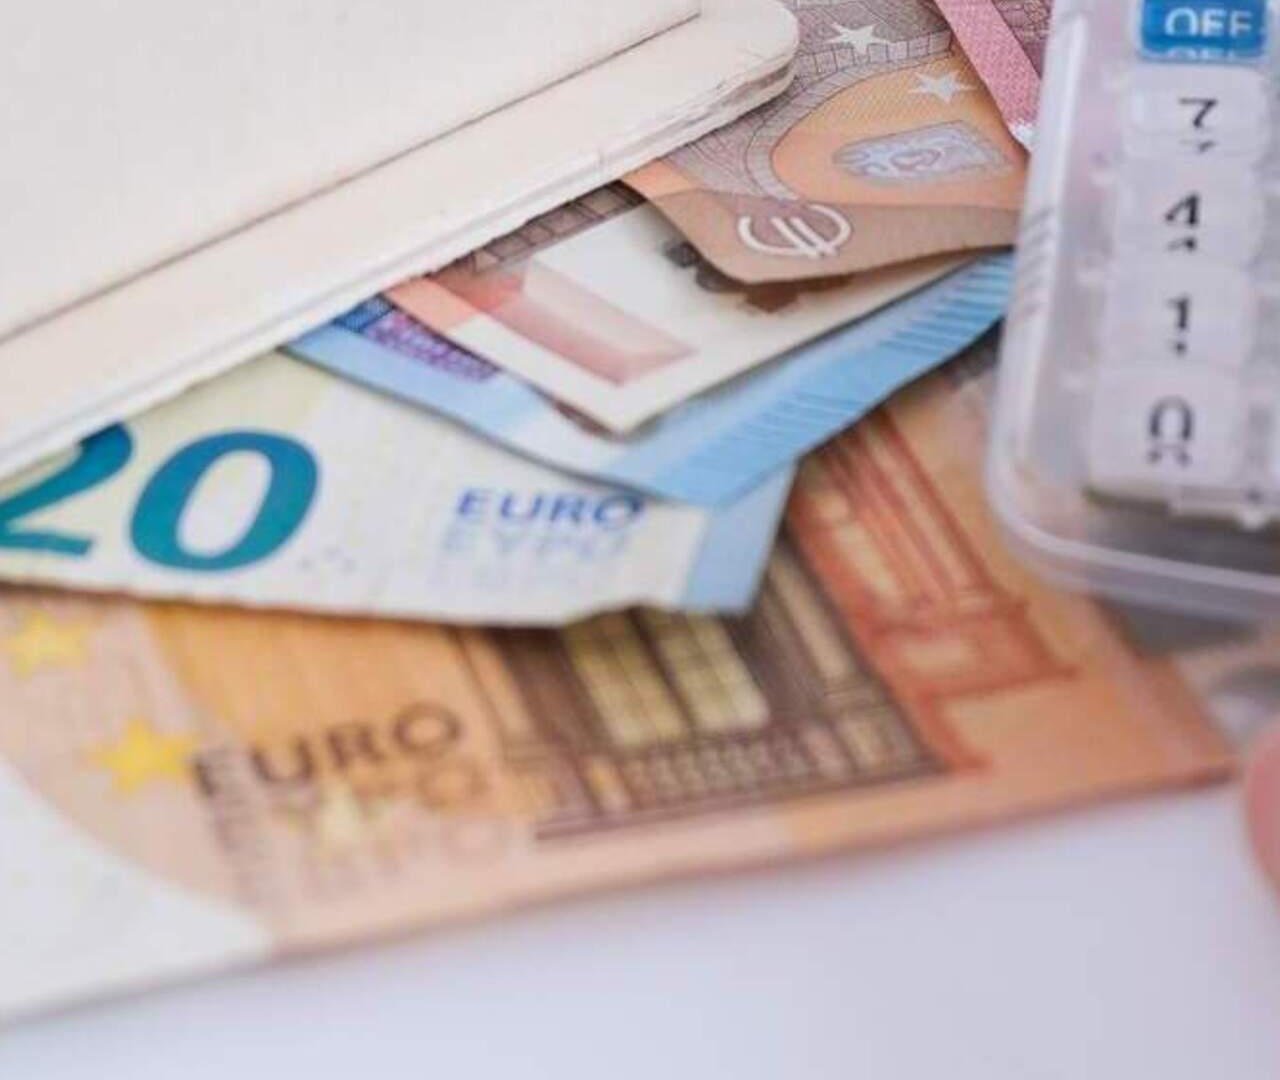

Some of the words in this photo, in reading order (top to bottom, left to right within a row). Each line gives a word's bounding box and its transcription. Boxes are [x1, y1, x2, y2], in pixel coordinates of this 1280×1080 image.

[1165, 7, 1252, 38] OFF
[1178, 96, 1218, 134] 7
[1163, 192, 1199, 234] 4
[456, 487, 644, 527] EURO
[190, 700, 463, 800] EURO
